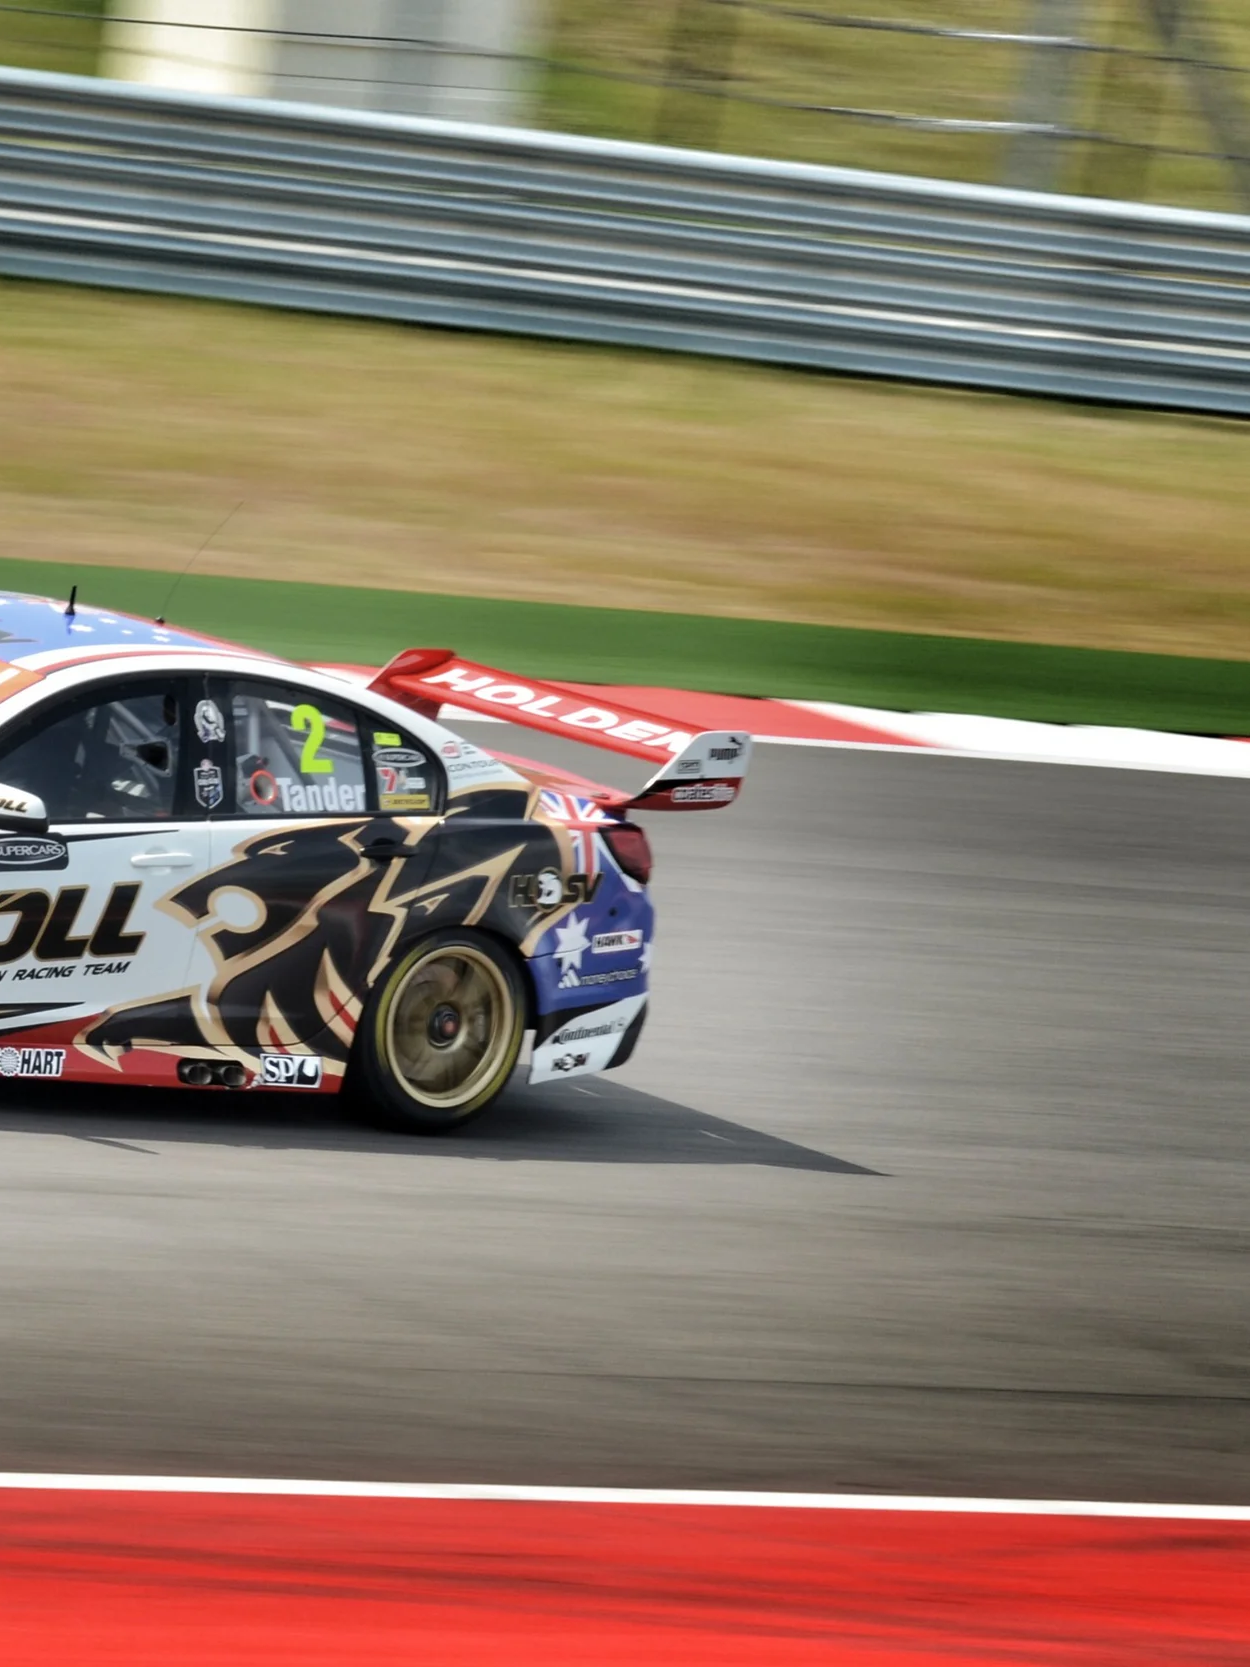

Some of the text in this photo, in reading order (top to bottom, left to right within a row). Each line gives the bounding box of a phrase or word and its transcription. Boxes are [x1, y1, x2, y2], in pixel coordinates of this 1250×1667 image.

[291, 704, 334, 773] 2
[276, 777, 366, 812] Tander
[12, 965, 76, 981] RACING
[83, 961, 131, 975] TEAM
[18, 1049, 65, 1076] HART
